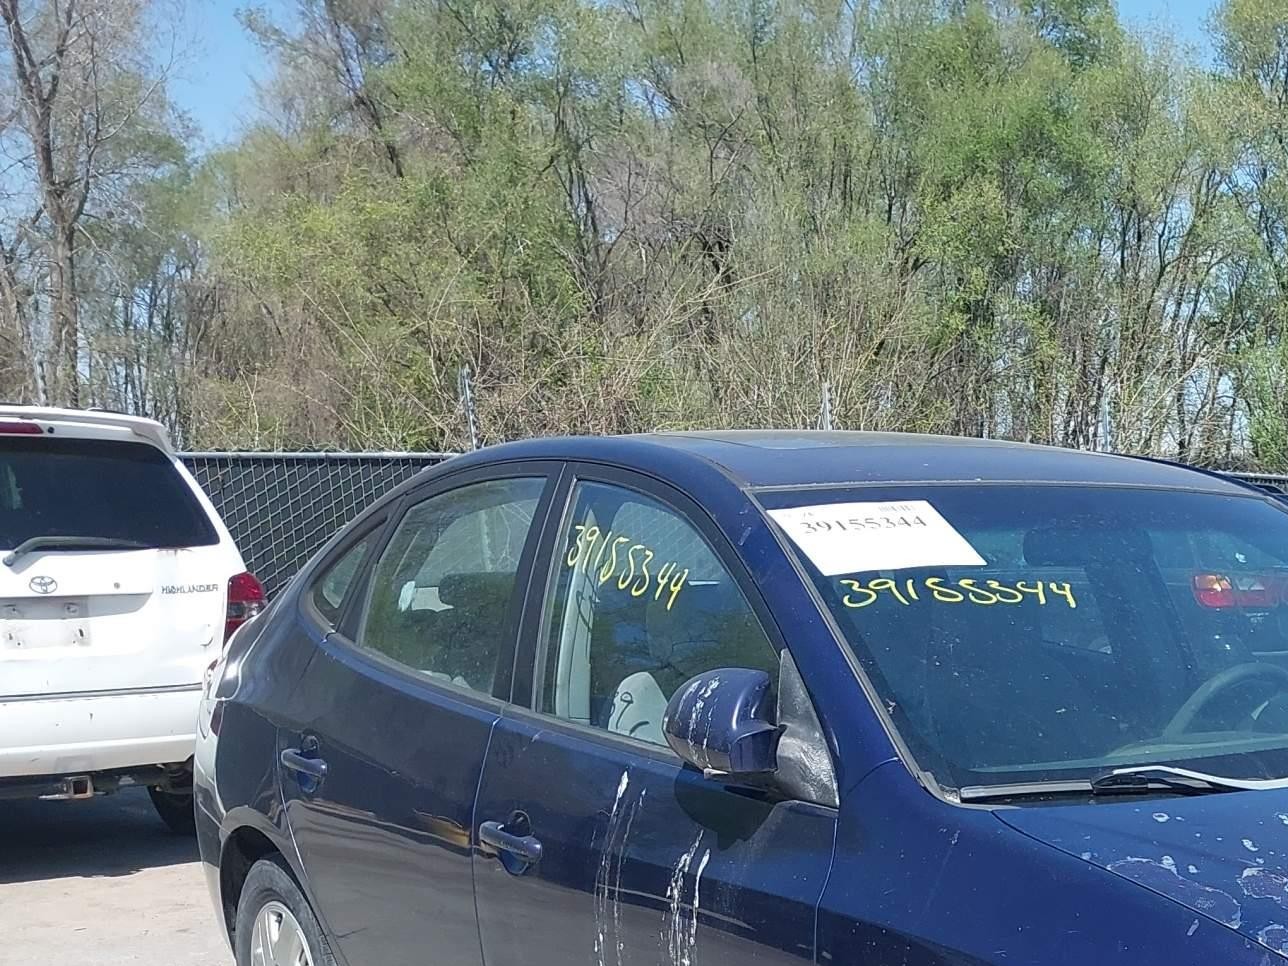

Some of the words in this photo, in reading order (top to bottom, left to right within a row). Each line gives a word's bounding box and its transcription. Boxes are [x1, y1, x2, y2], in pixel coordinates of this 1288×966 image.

[799, 515, 928, 534] 39155344
[567, 525, 689, 611] 39155344
[840, 577, 1077, 608] 39155344
